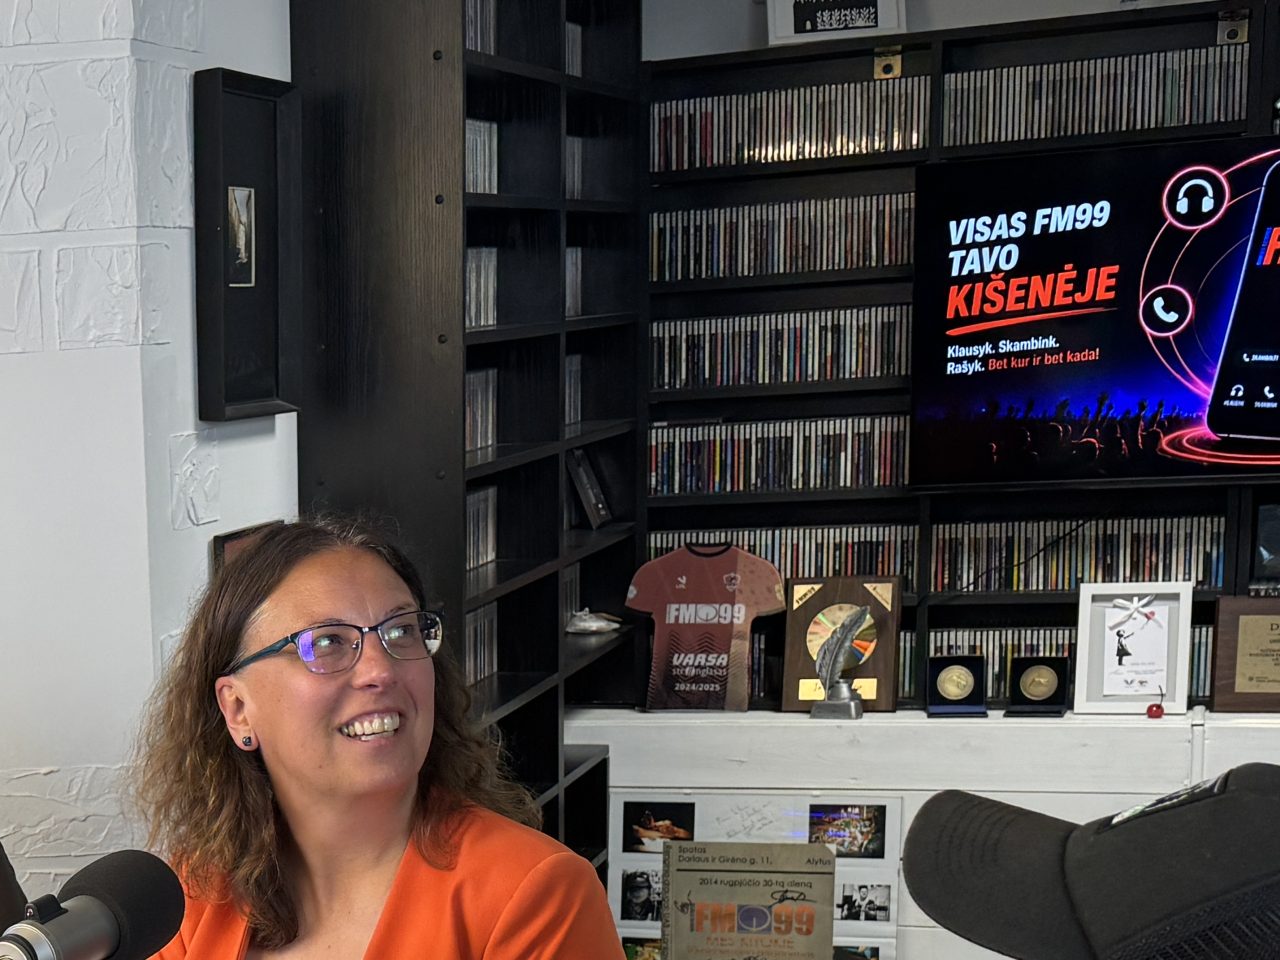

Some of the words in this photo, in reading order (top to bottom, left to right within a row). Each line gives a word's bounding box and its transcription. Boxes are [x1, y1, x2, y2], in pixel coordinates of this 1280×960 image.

[949, 211, 1027, 247] VISAS
[1033, 200, 1112, 236] FM99
[948, 243, 1020, 277] TAVO
[946, 263, 1120, 319] KIŠENĖJE
[947, 341, 996, 358] Klausyk.
[998, 335, 1060, 353] Skambink.
[946, 359, 985, 375] Rašyk.
[988, 358, 1008, 371] Bet
[1011, 357, 1030, 369] kur
[1033, 354, 1042, 366] ir
[1044, 352, 1064, 365] bet
[1066, 347, 1100, 363] kada!
[672, 653, 729, 666] VARSA
[674, 683, 721, 691] 2024/2025
[678, 855, 710, 863] Dariaus
[806, 858, 832, 867] Alytus
[699, 878, 719, 886] 2014
